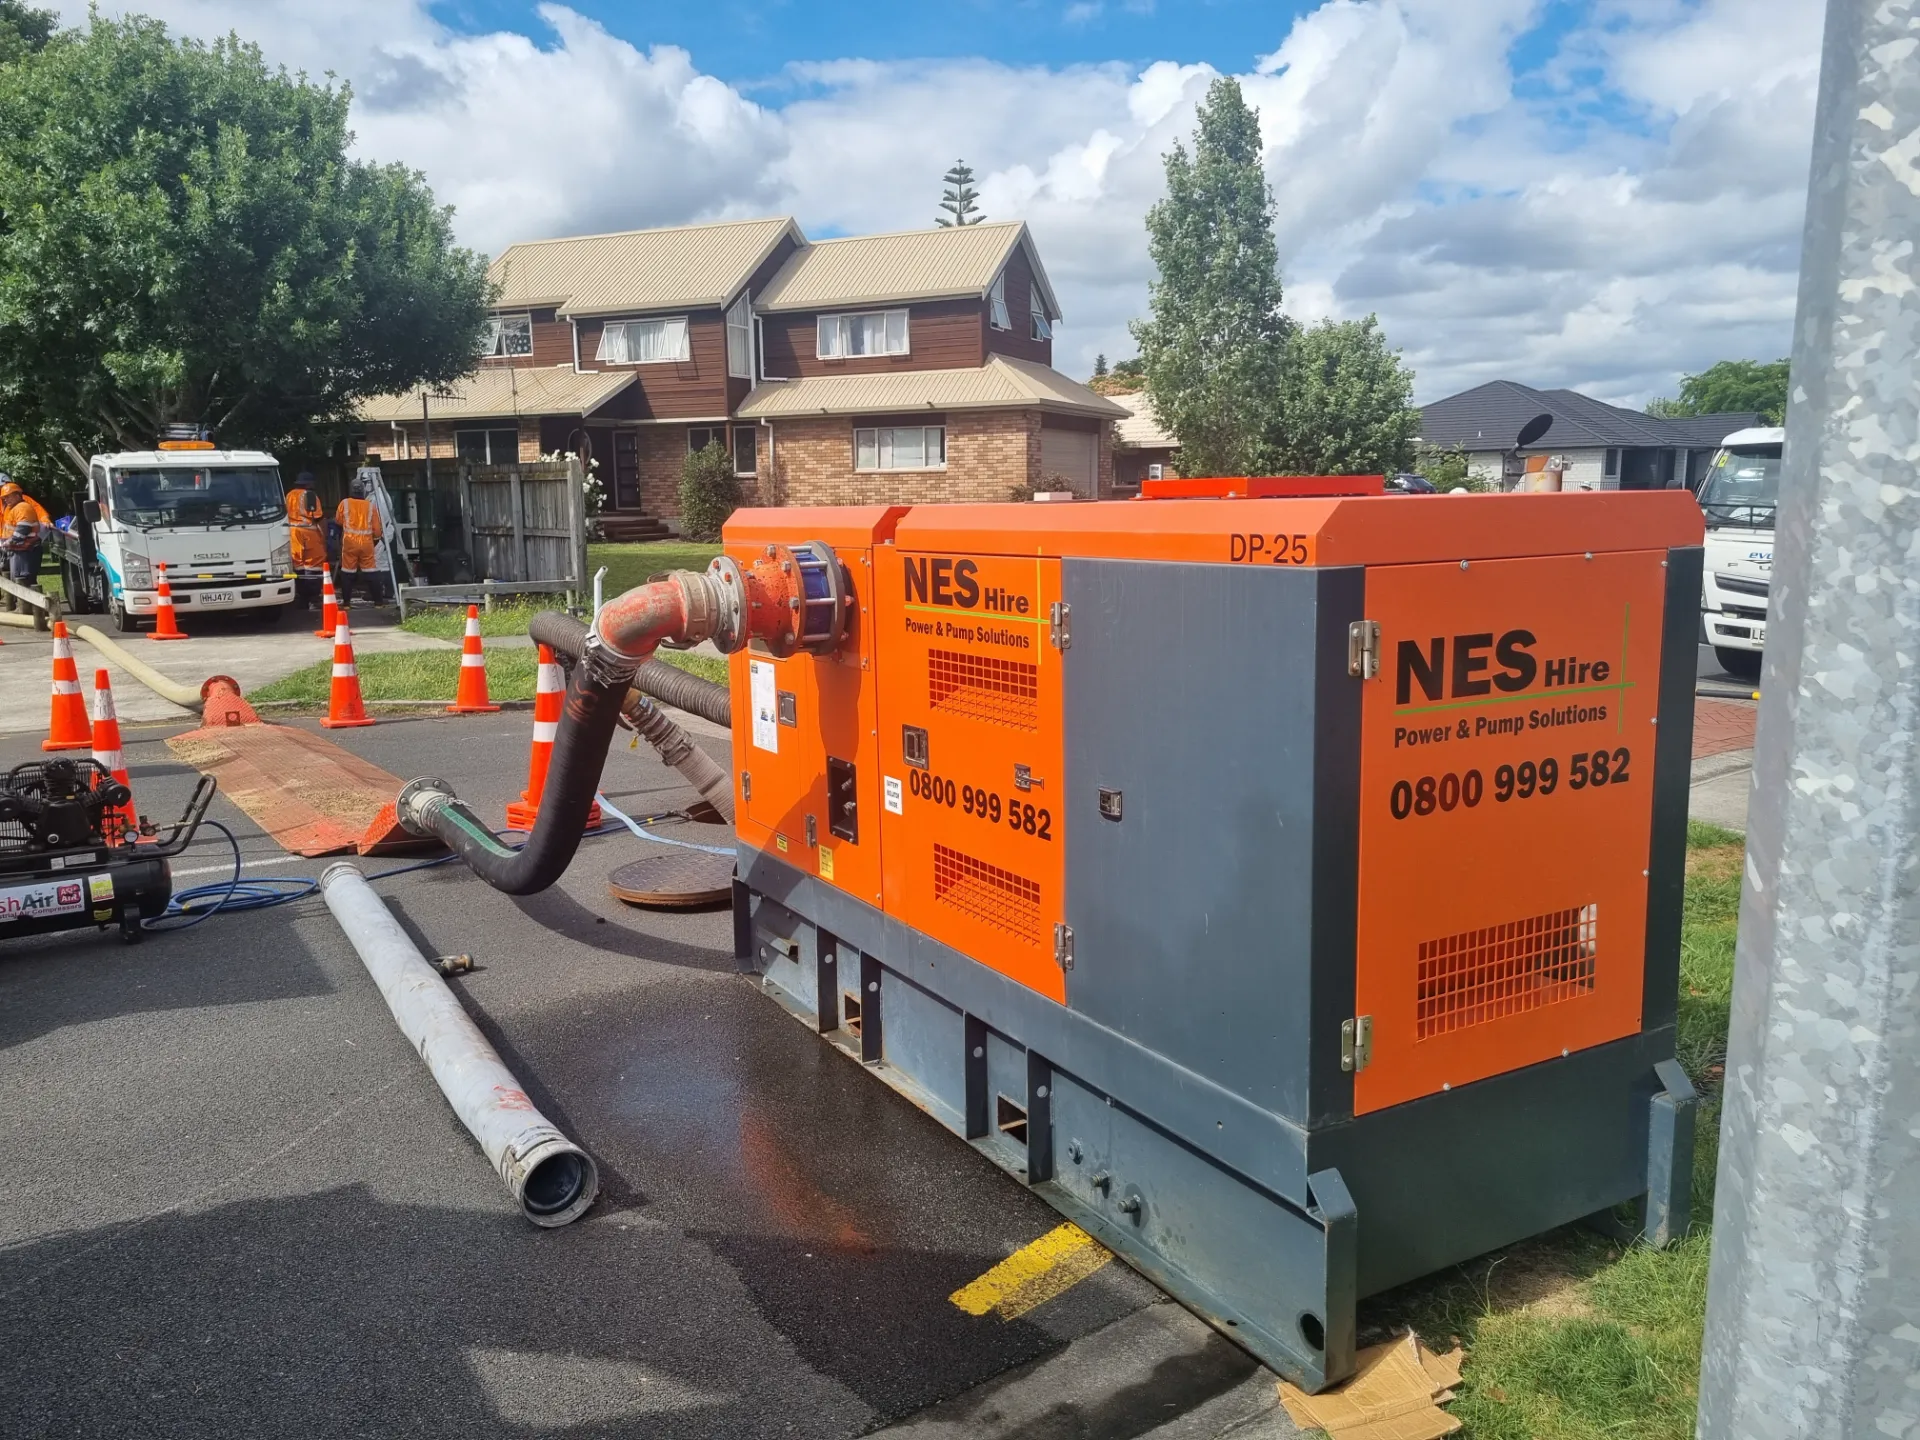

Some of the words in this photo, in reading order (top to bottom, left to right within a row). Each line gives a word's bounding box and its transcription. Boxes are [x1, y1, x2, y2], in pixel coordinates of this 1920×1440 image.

[1230, 533, 1308, 565] DP-25
[202, 592, 232, 602] HHJ472
[904, 557, 979, 608] NES
[984, 588, 1029, 614] Hire
[905, 617, 933, 636] Power
[936, 621, 943, 637] &
[946, 622, 974, 644] Pump
[976, 626, 1030, 649] Solutions
[1396, 629, 1537, 705] NES
[1544, 656, 1610, 687] Hire
[1394, 725, 1452, 748] Power
[1456, 718, 1470, 739] &
[1475, 715, 1524, 737] Pump
[1528, 704, 1607, 730] Solutions
[909, 768, 956, 809] 0800
[962, 785, 1002, 824] 999
[1008, 798, 1052, 842] 582
[1390, 768, 1483, 820] 0800
[1494, 757, 1558, 803] 999
[1569, 747, 1630, 790] 582
